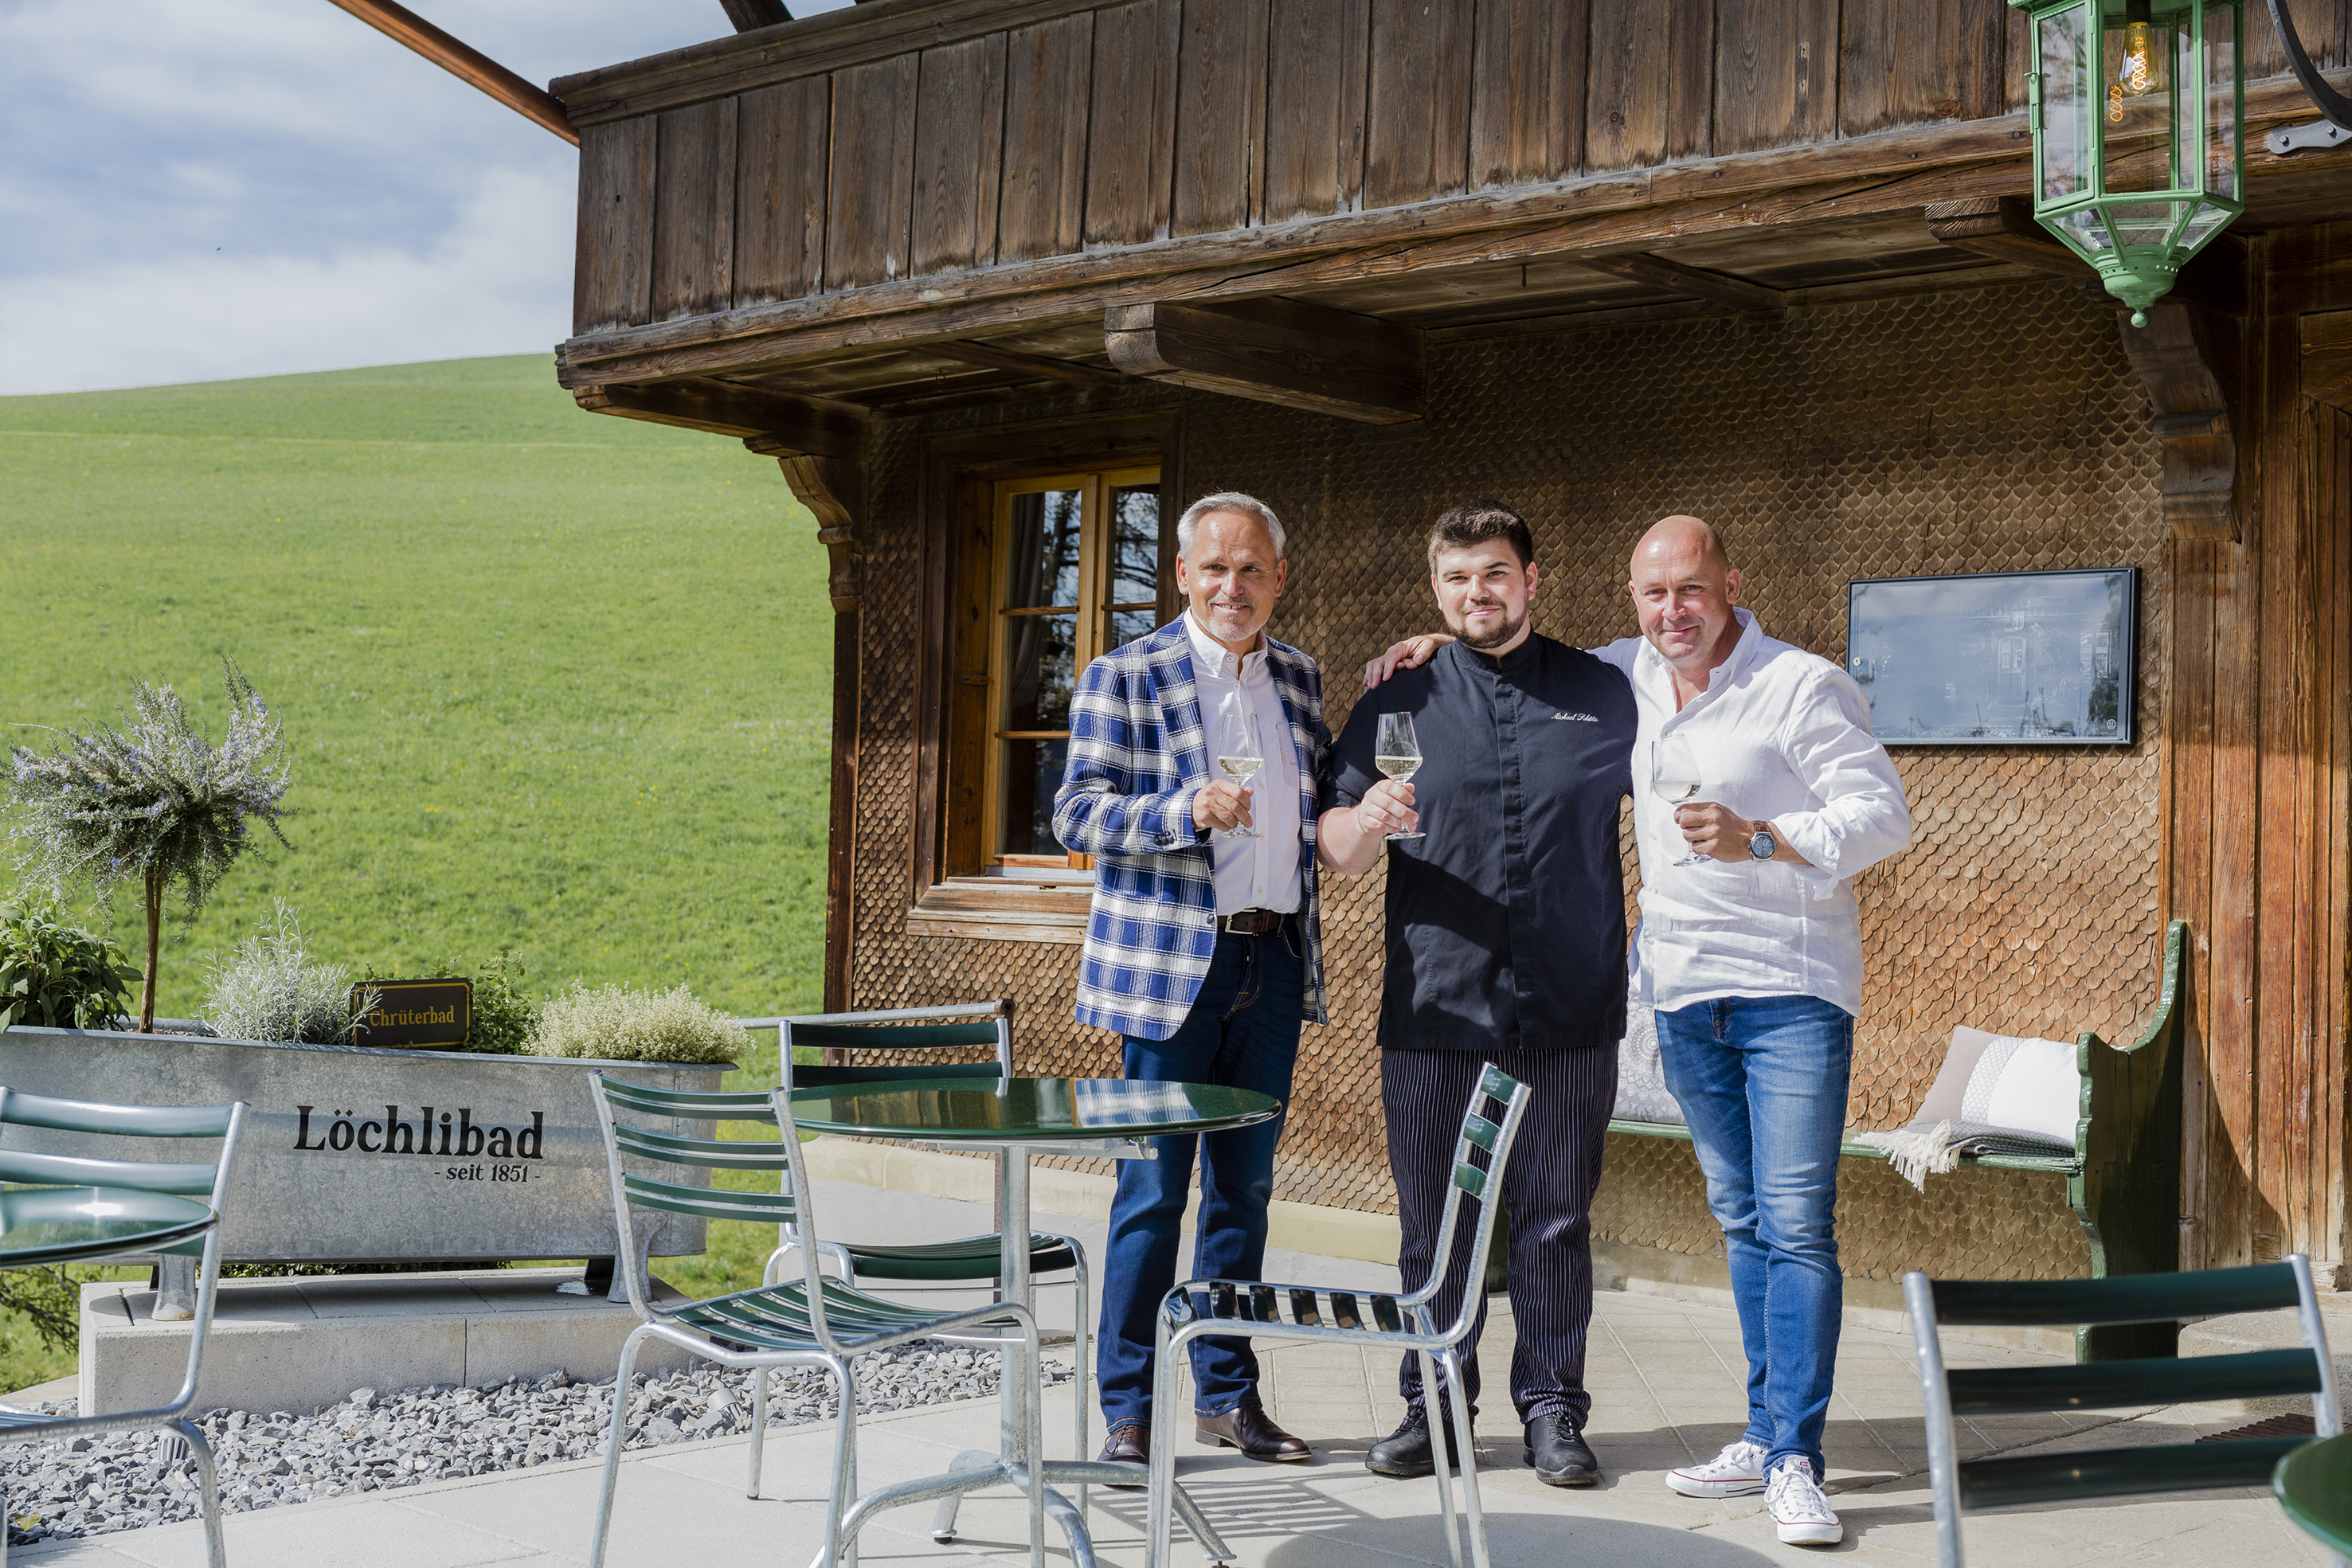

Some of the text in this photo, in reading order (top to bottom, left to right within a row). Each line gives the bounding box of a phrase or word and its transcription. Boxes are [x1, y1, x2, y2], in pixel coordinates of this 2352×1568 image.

[1551, 712, 1577, 721] Michael
[370, 1005, 455, 1026] Chrüterbad
[293, 1105, 544, 1159] Löchlibad
[446, 1163, 484, 1181] seit
[491, 1164, 528, 1183] 1851
